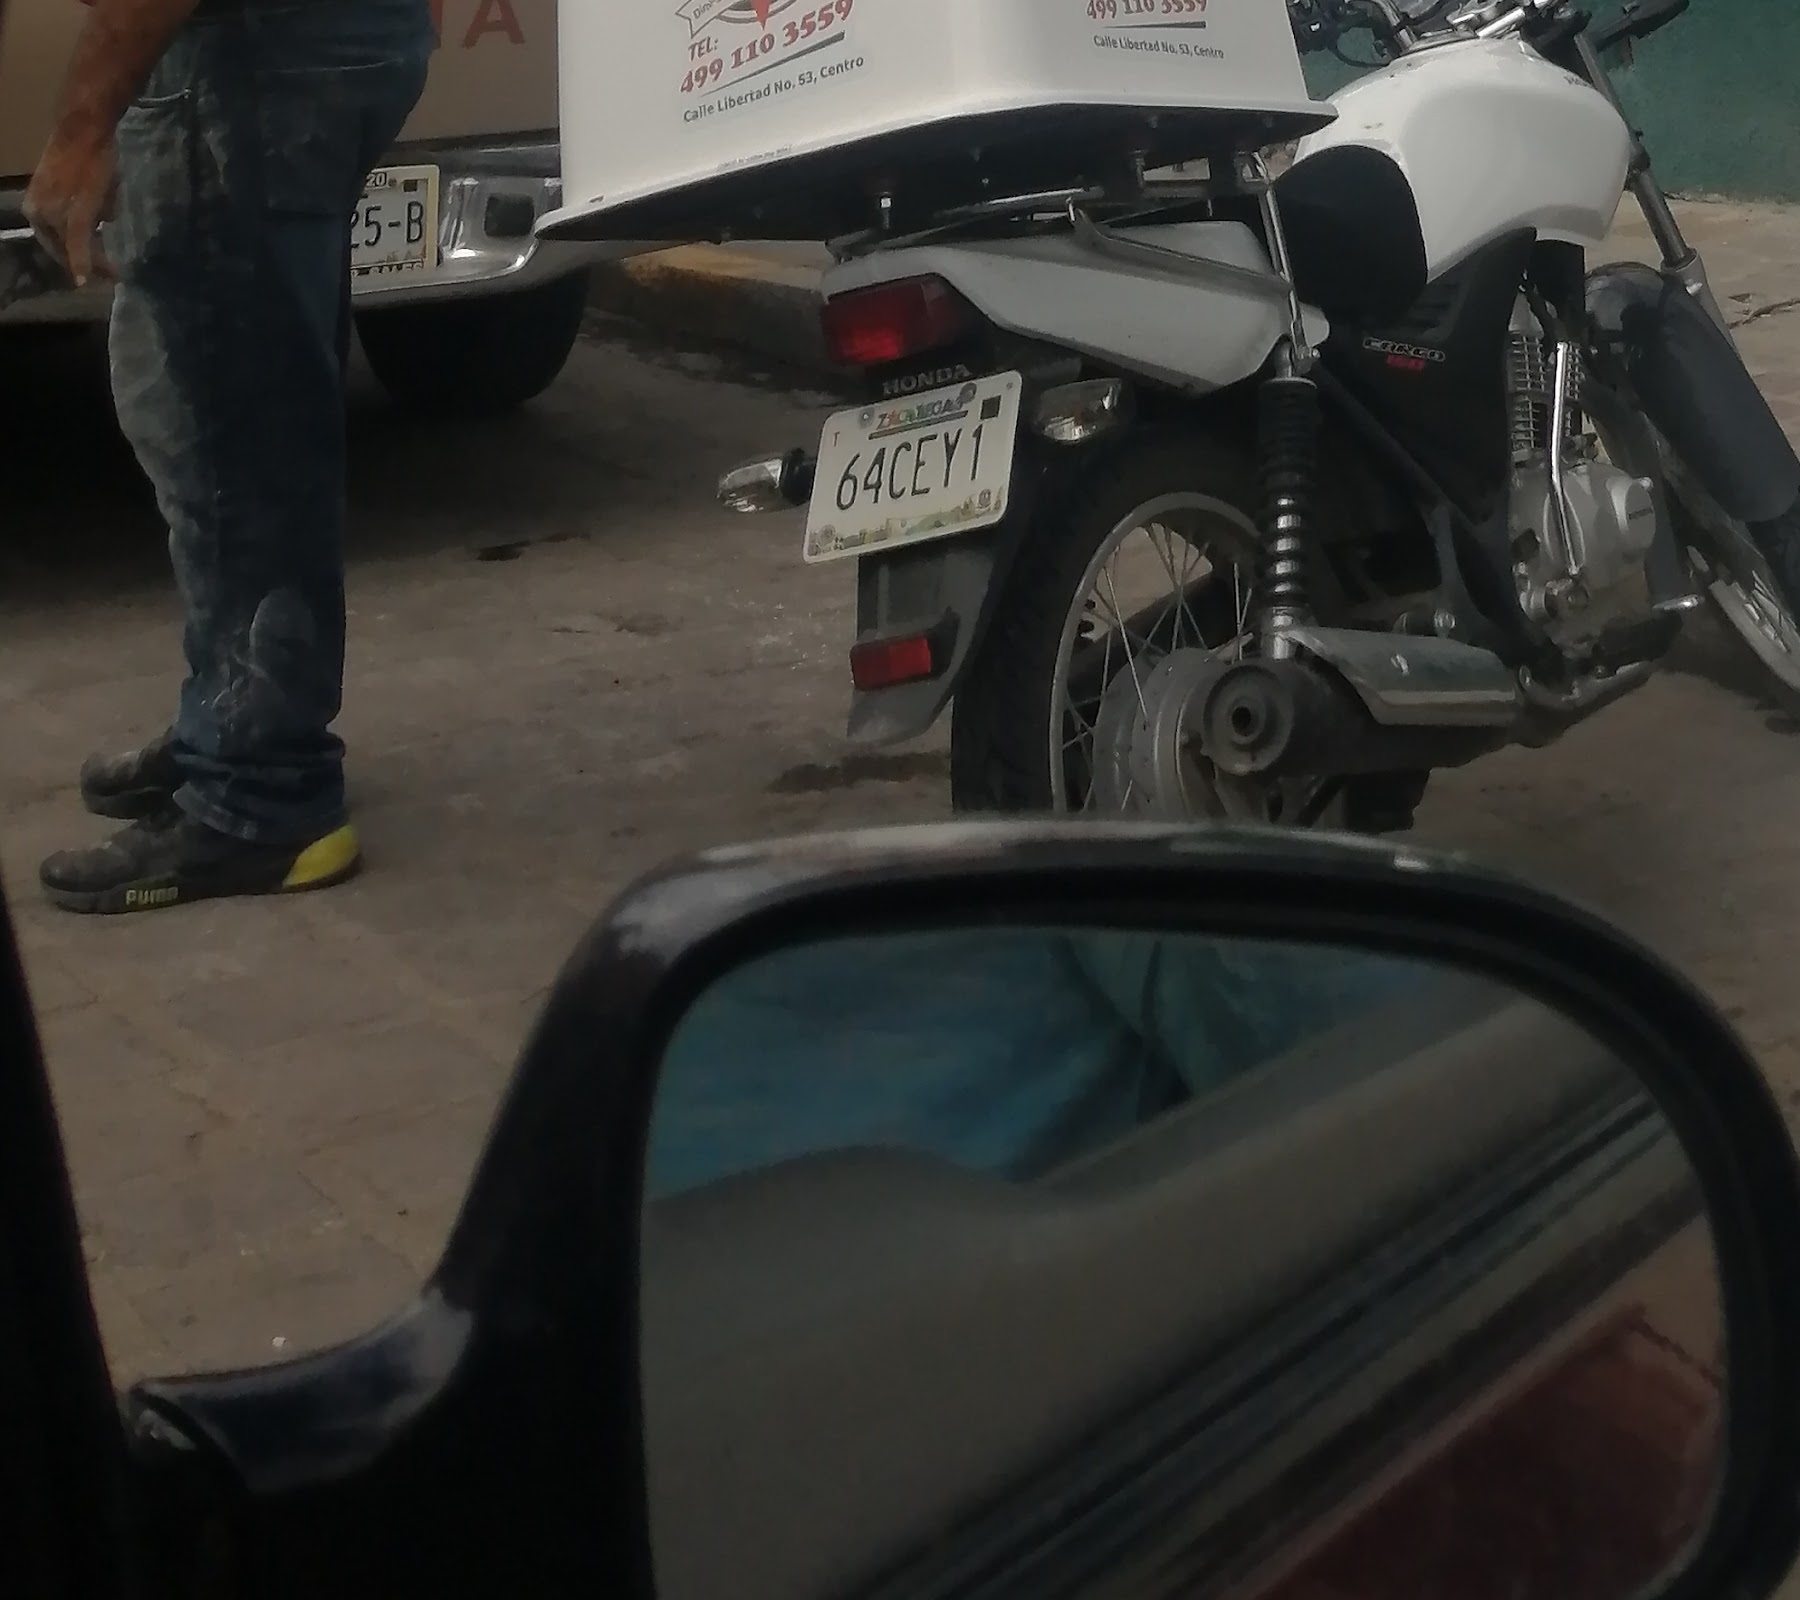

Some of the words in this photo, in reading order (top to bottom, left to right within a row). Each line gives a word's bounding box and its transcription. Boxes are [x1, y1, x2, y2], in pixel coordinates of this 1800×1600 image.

[680, 58, 724, 93] 499
[731, 33, 775, 69] 110
[688, 36, 719, 62] TEL:
[1093, 35, 1118, 48] Calle
[1119, 37, 1160, 52] Libertad
[1194, 45, 1225, 59] Centro
[683, 104, 715, 123] Calle
[717, 84, 771, 113] Libertad
[774, 76, 796, 94] No.
[820, 56, 864, 79] Centro
[883, 363, 972, 396] HONDA
[836, 423, 983, 511] 64CEY1
